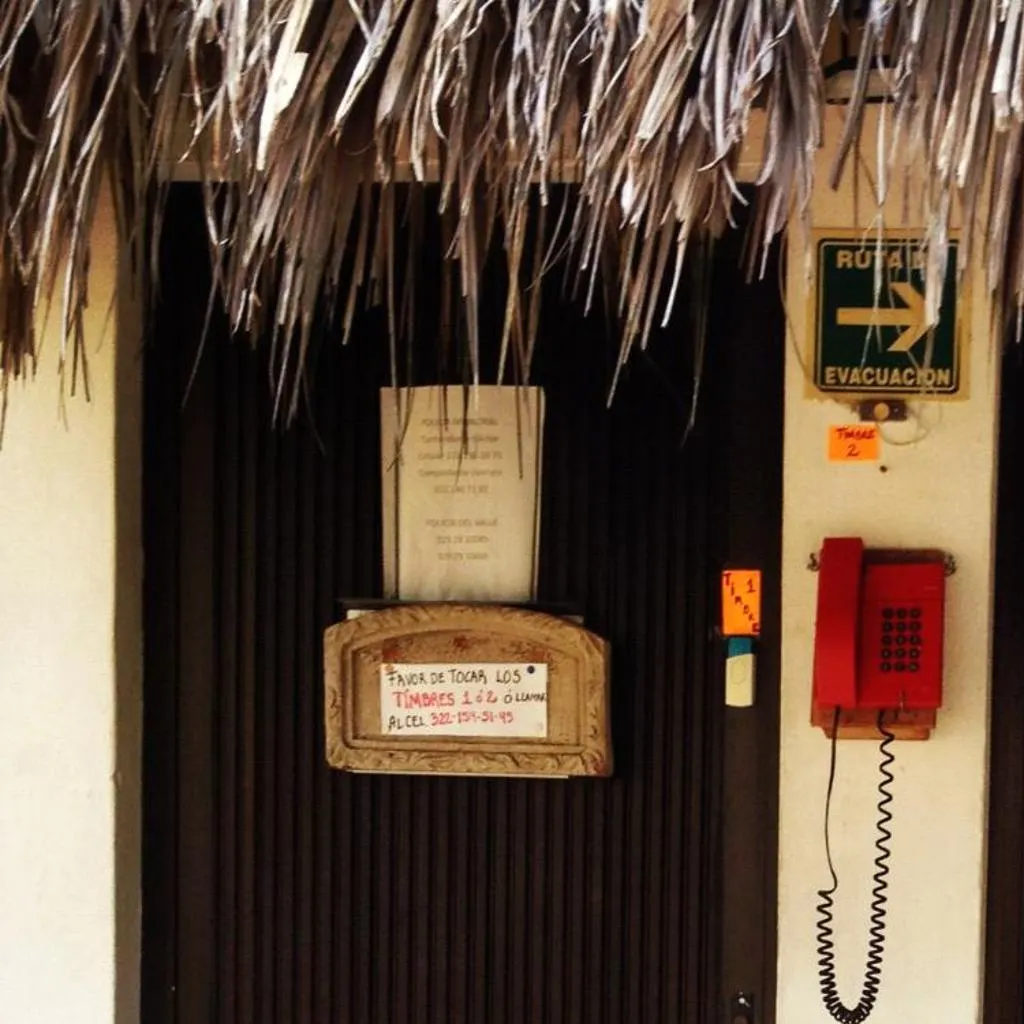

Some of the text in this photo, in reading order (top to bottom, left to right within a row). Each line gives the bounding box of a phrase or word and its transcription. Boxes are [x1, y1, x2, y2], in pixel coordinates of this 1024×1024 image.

[848, 443, 860, 457] 2
[747, 578, 756, 593] 1
[387, 669, 522, 687] FAVOR DE TOCAR LOS
[461, 691, 473, 705] 1
[486, 690, 498, 704] 2
